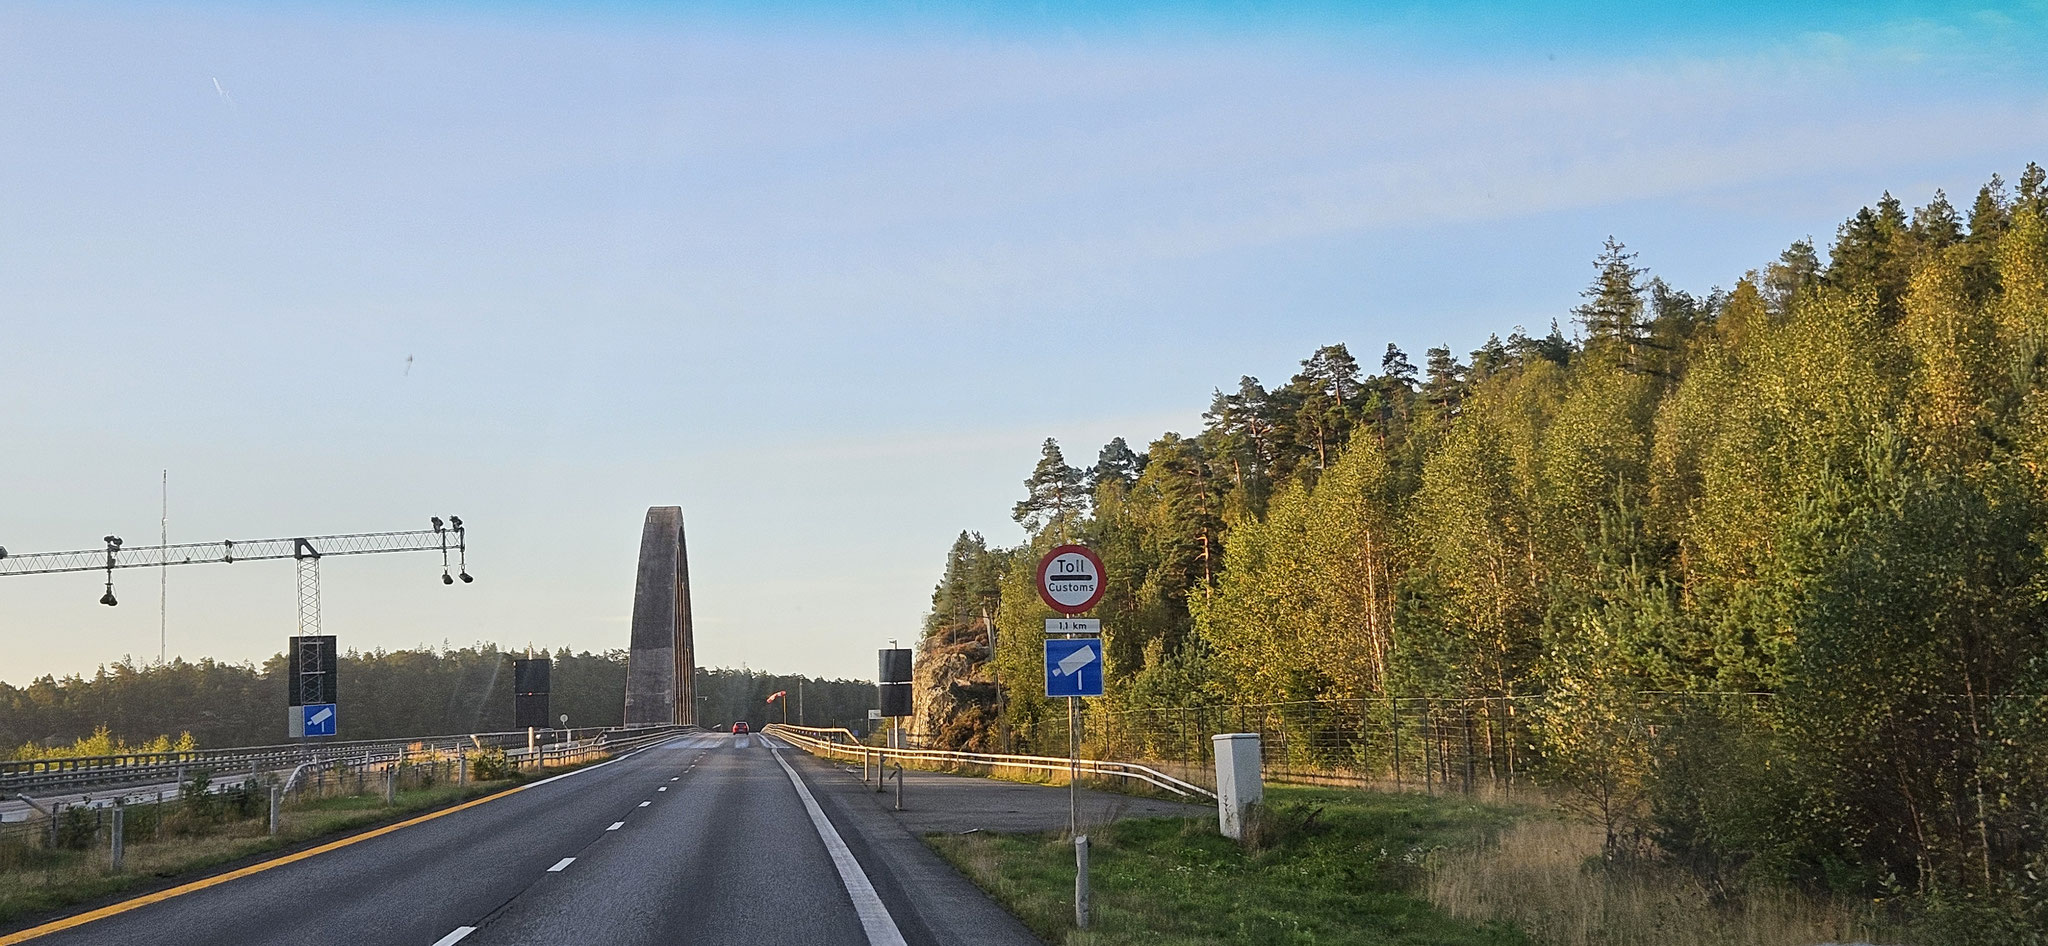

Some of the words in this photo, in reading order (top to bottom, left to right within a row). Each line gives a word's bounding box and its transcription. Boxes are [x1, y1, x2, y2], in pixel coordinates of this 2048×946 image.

[1057, 559, 1084, 573] Toll
[1048, 582, 1094, 592] Customs
[1072, 621, 1087, 630] km
